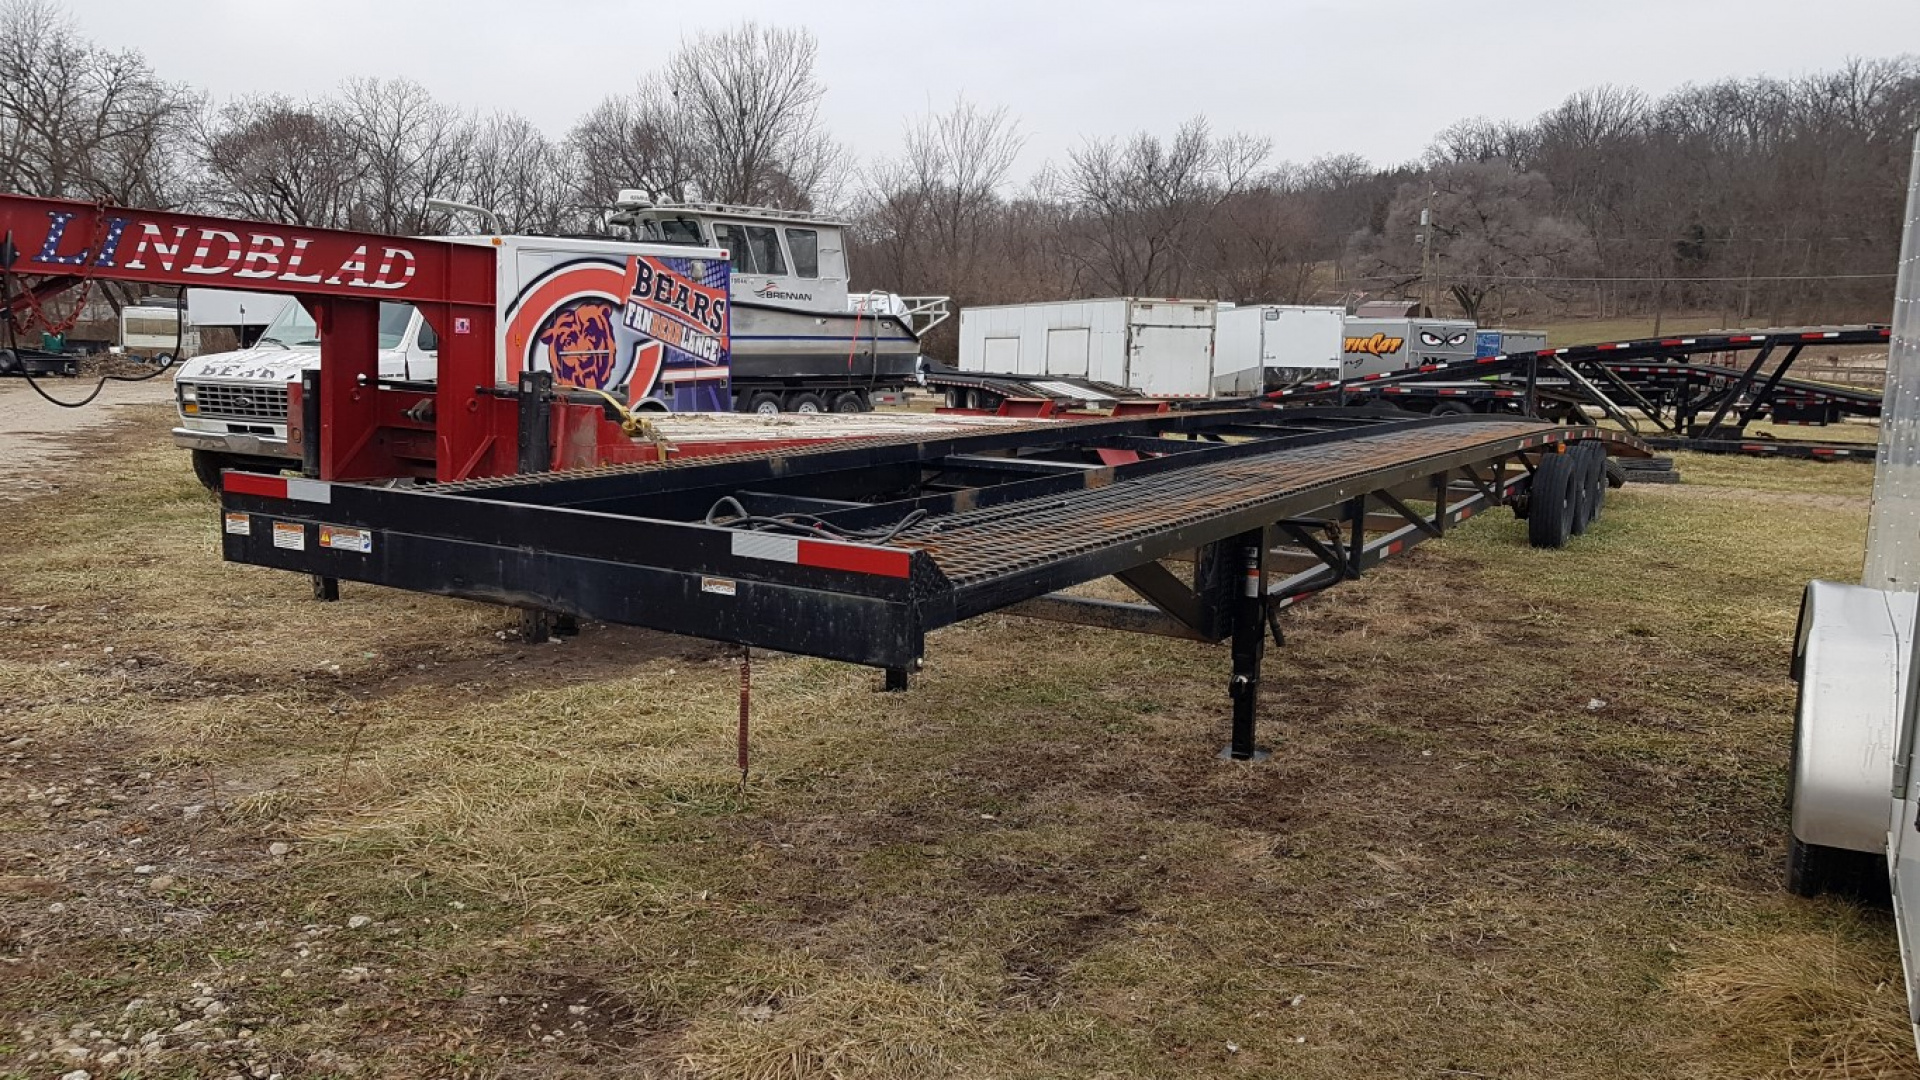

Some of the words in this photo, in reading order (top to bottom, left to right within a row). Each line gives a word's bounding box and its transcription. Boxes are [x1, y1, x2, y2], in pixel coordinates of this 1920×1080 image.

[31, 211, 415, 289] LINDBLAD
[631, 257, 726, 334] BEARS
[766, 291, 812, 301] BRENNAN
